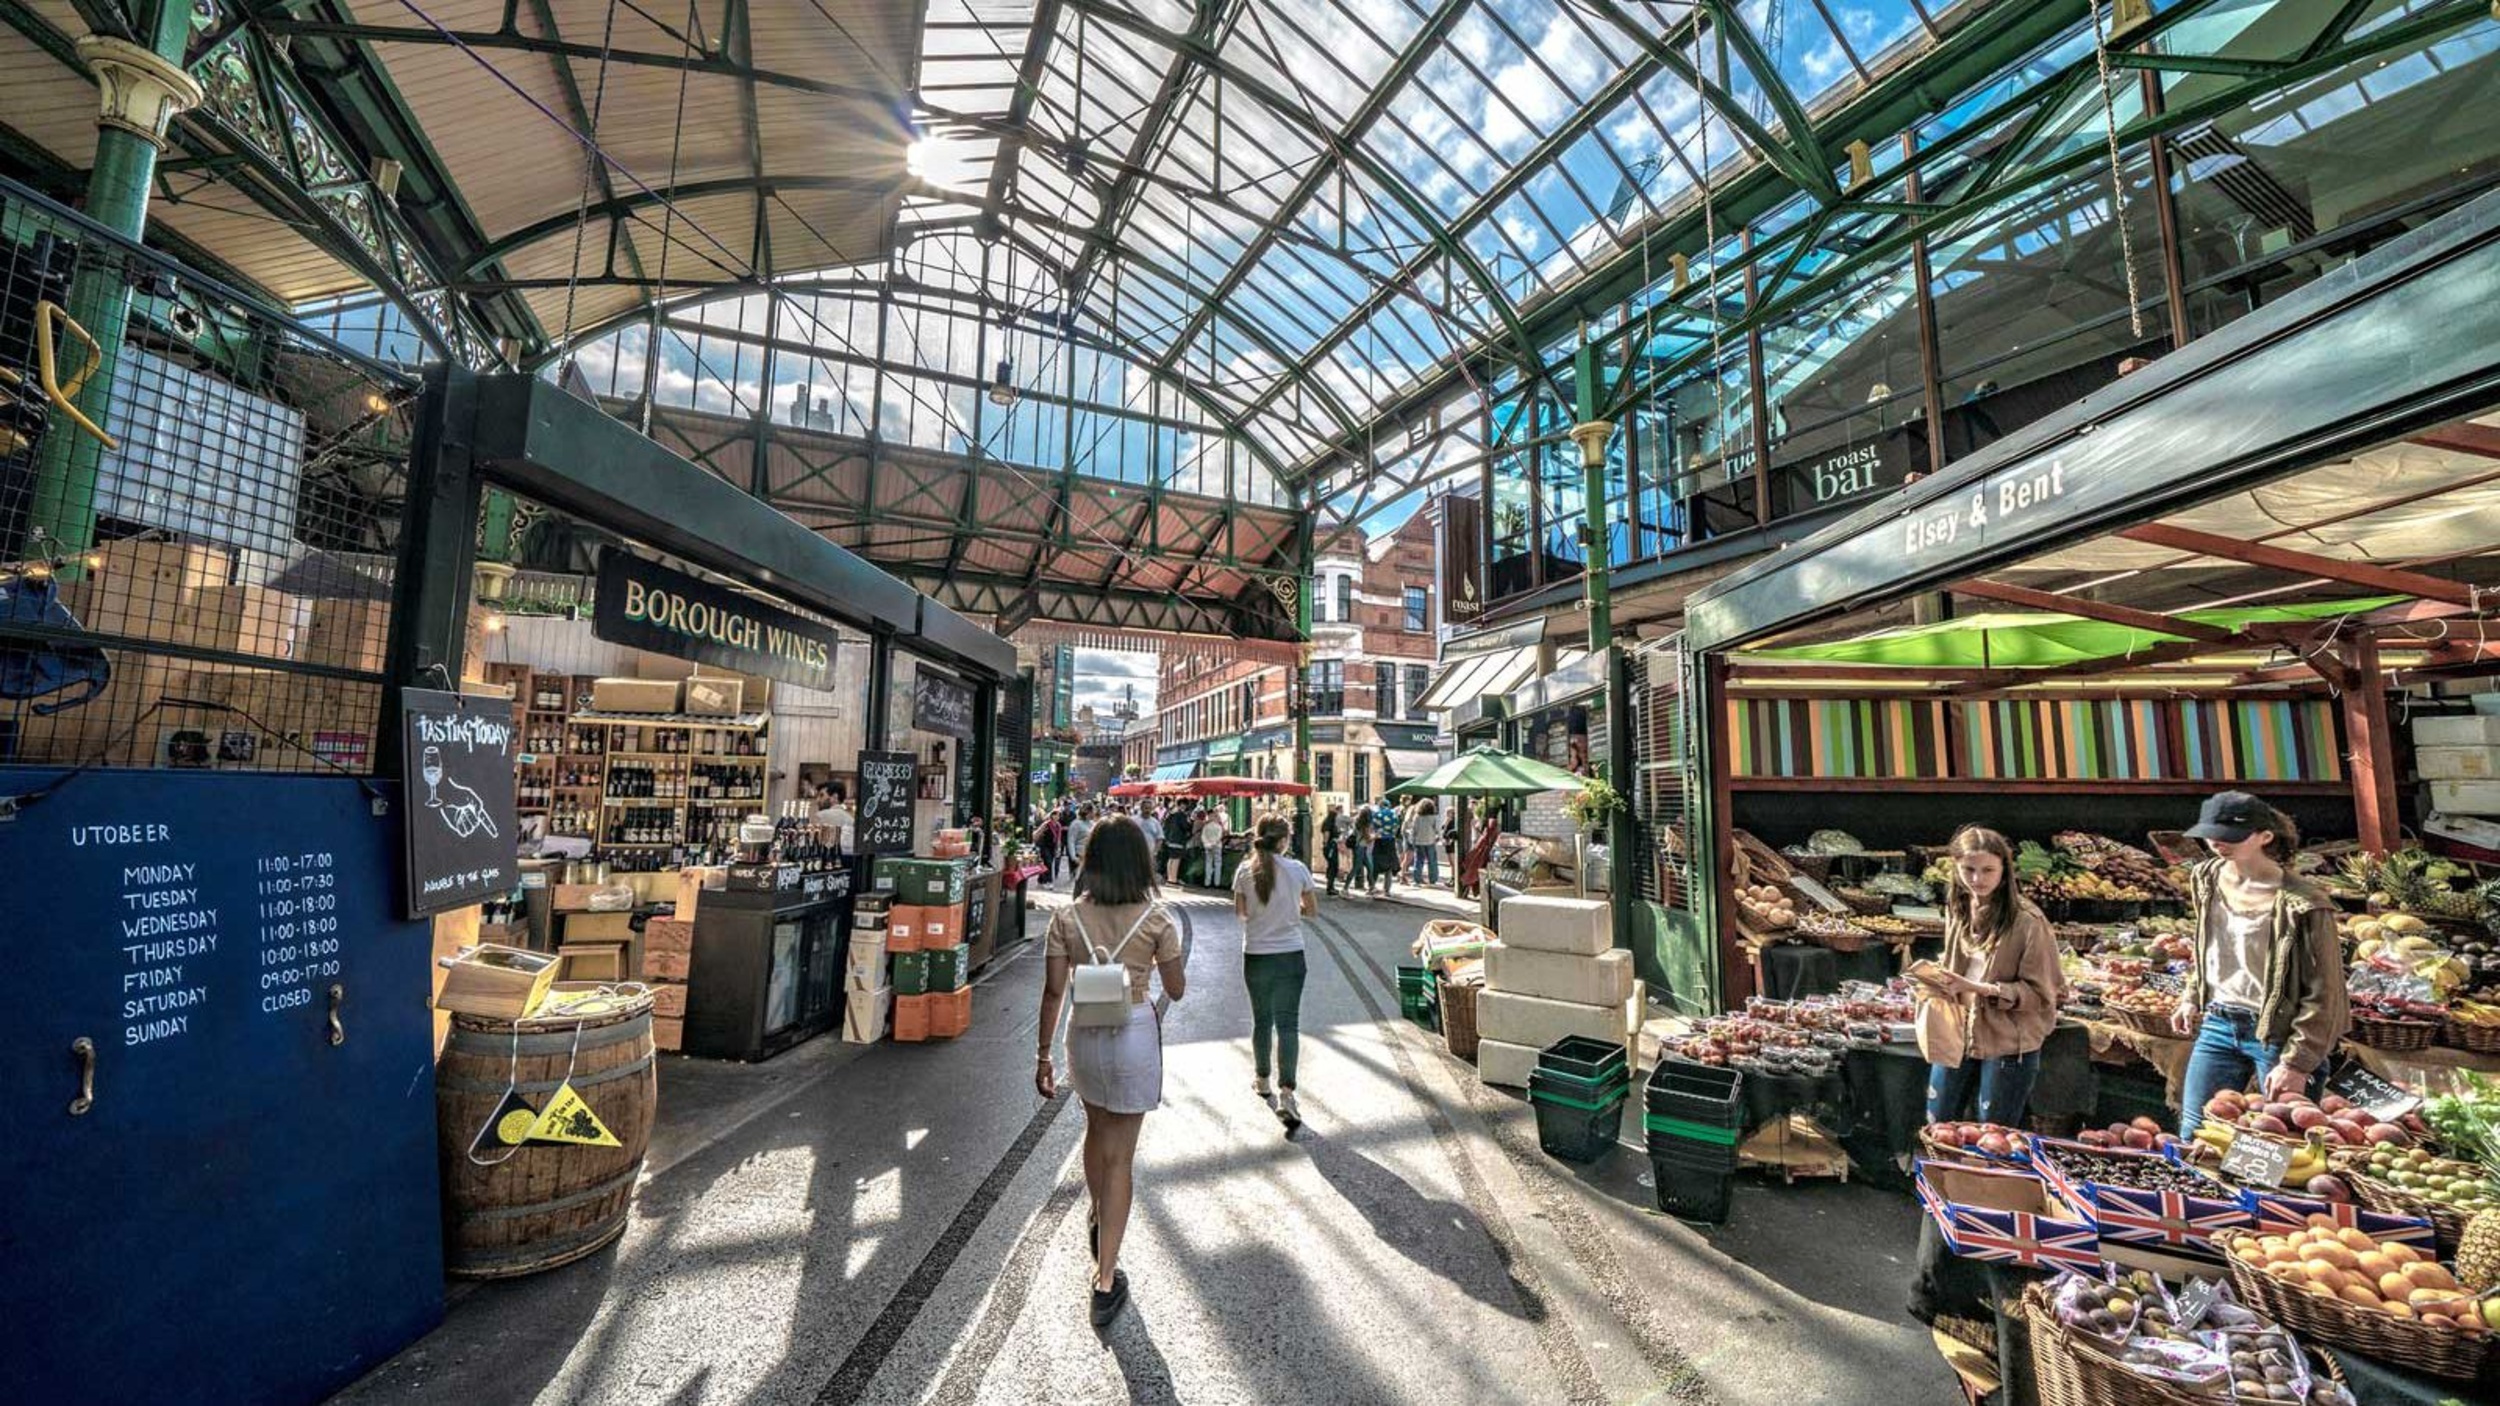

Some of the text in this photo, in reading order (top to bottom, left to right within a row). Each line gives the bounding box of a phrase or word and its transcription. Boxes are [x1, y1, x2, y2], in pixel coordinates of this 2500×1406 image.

[1827, 443, 1877, 472] roast
[1812, 458, 1882, 503] bar
[1906, 460, 2063, 555] Elsey & Bent
[1452, 599, 1480, 611] roast
[625, 579, 828, 669] BOROUGH WINES
[1412, 732, 1437, 746] MON
[72, 824, 171, 847] UTOBEER
[124, 863, 196, 886] MONDAY
[123, 888, 198, 910] TUESDAY
[122, 909, 217, 938] WEDNESDAY
[123, 935, 217, 965] THURSDAY
[124, 966, 182, 993] FRIDAY
[123, 986, 207, 1019] SATURDAY
[125, 988, 312, 1046] SUNDAY CLOSED
[2354, 1067, 2405, 1101] PEACHE
